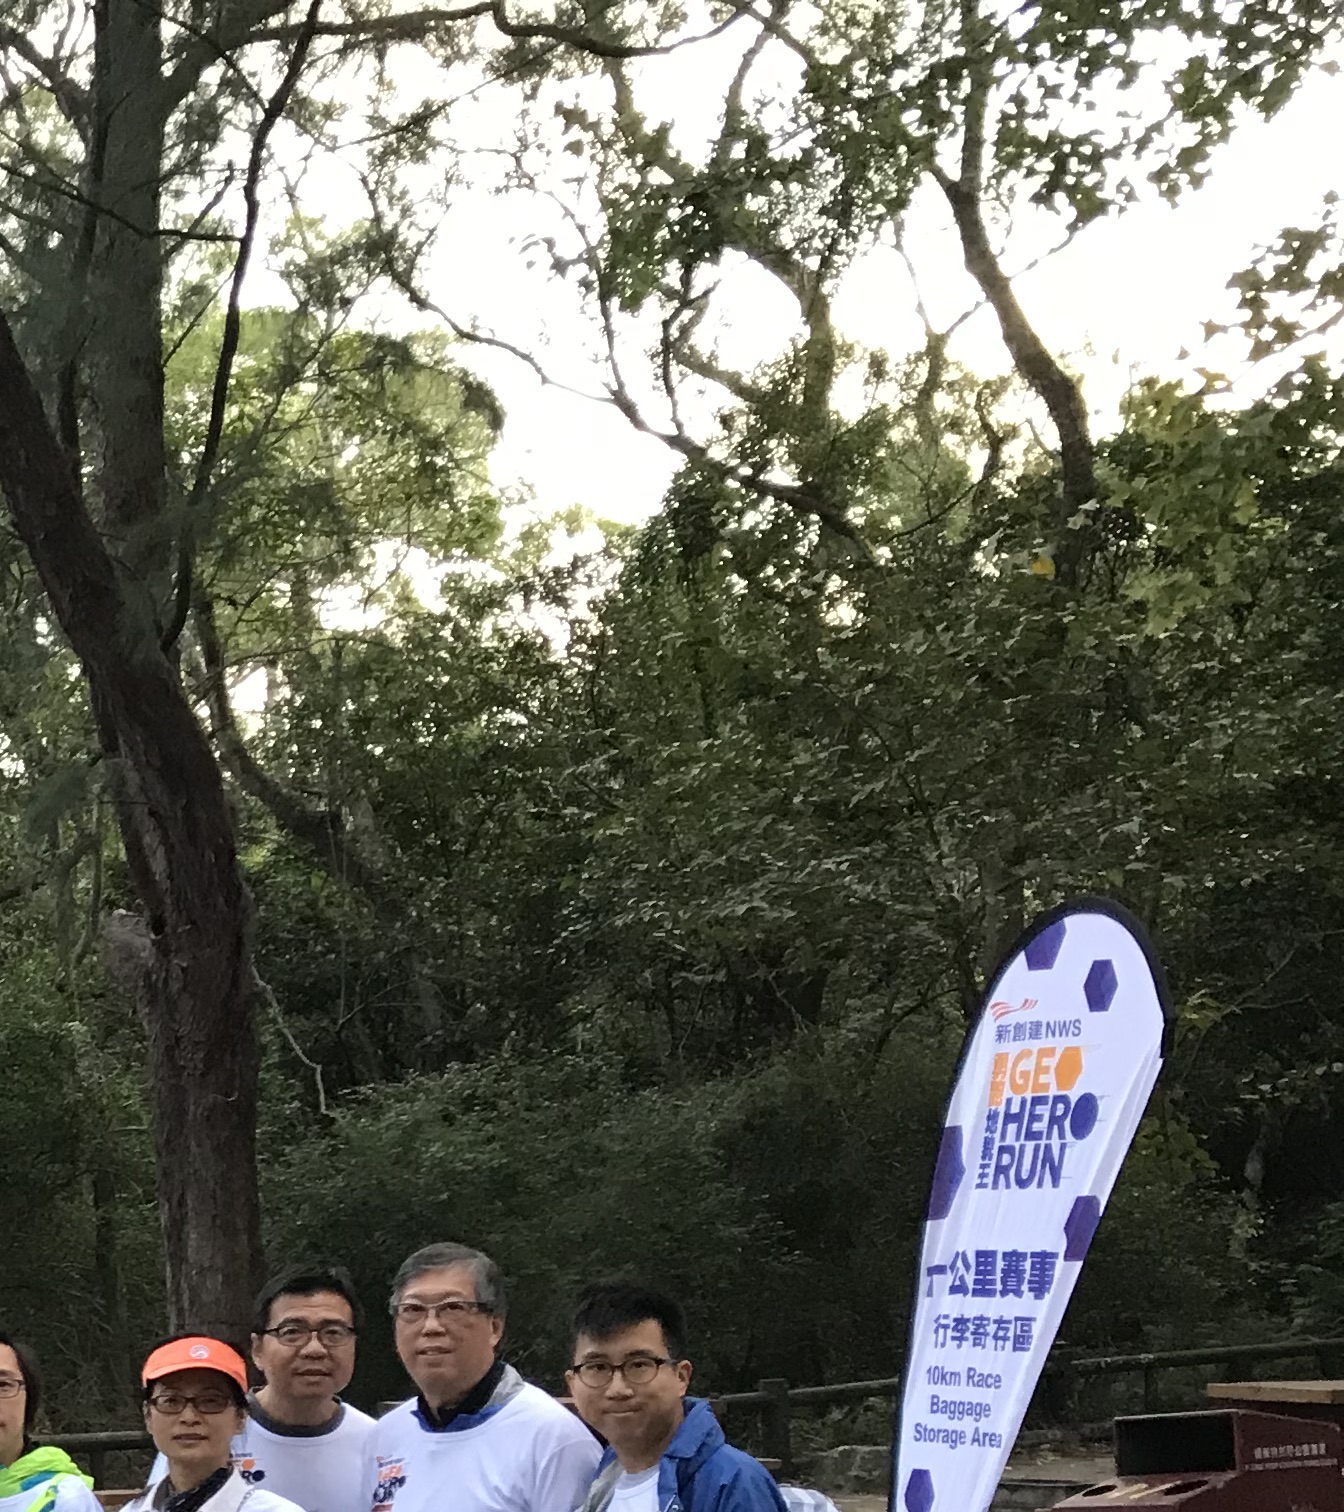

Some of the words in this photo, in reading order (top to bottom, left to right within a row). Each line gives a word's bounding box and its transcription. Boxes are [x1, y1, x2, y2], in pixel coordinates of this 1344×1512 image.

[995, 1020, 1044, 1044] 新創建
[1045, 1018, 1083, 1038] NWS
[999, 1091, 1099, 1143] HERO
[991, 1142, 1068, 1190] RUN
[933, 1314, 1037, 1352] 行李寄存區
[926, 1365, 961, 1387] 10km
[966, 1366, 1002, 1389] Race
[929, 1394, 992, 1423] Baggage
[913, 1422, 967, 1450] Storage
[970, 1426, 1002, 1449] Area
